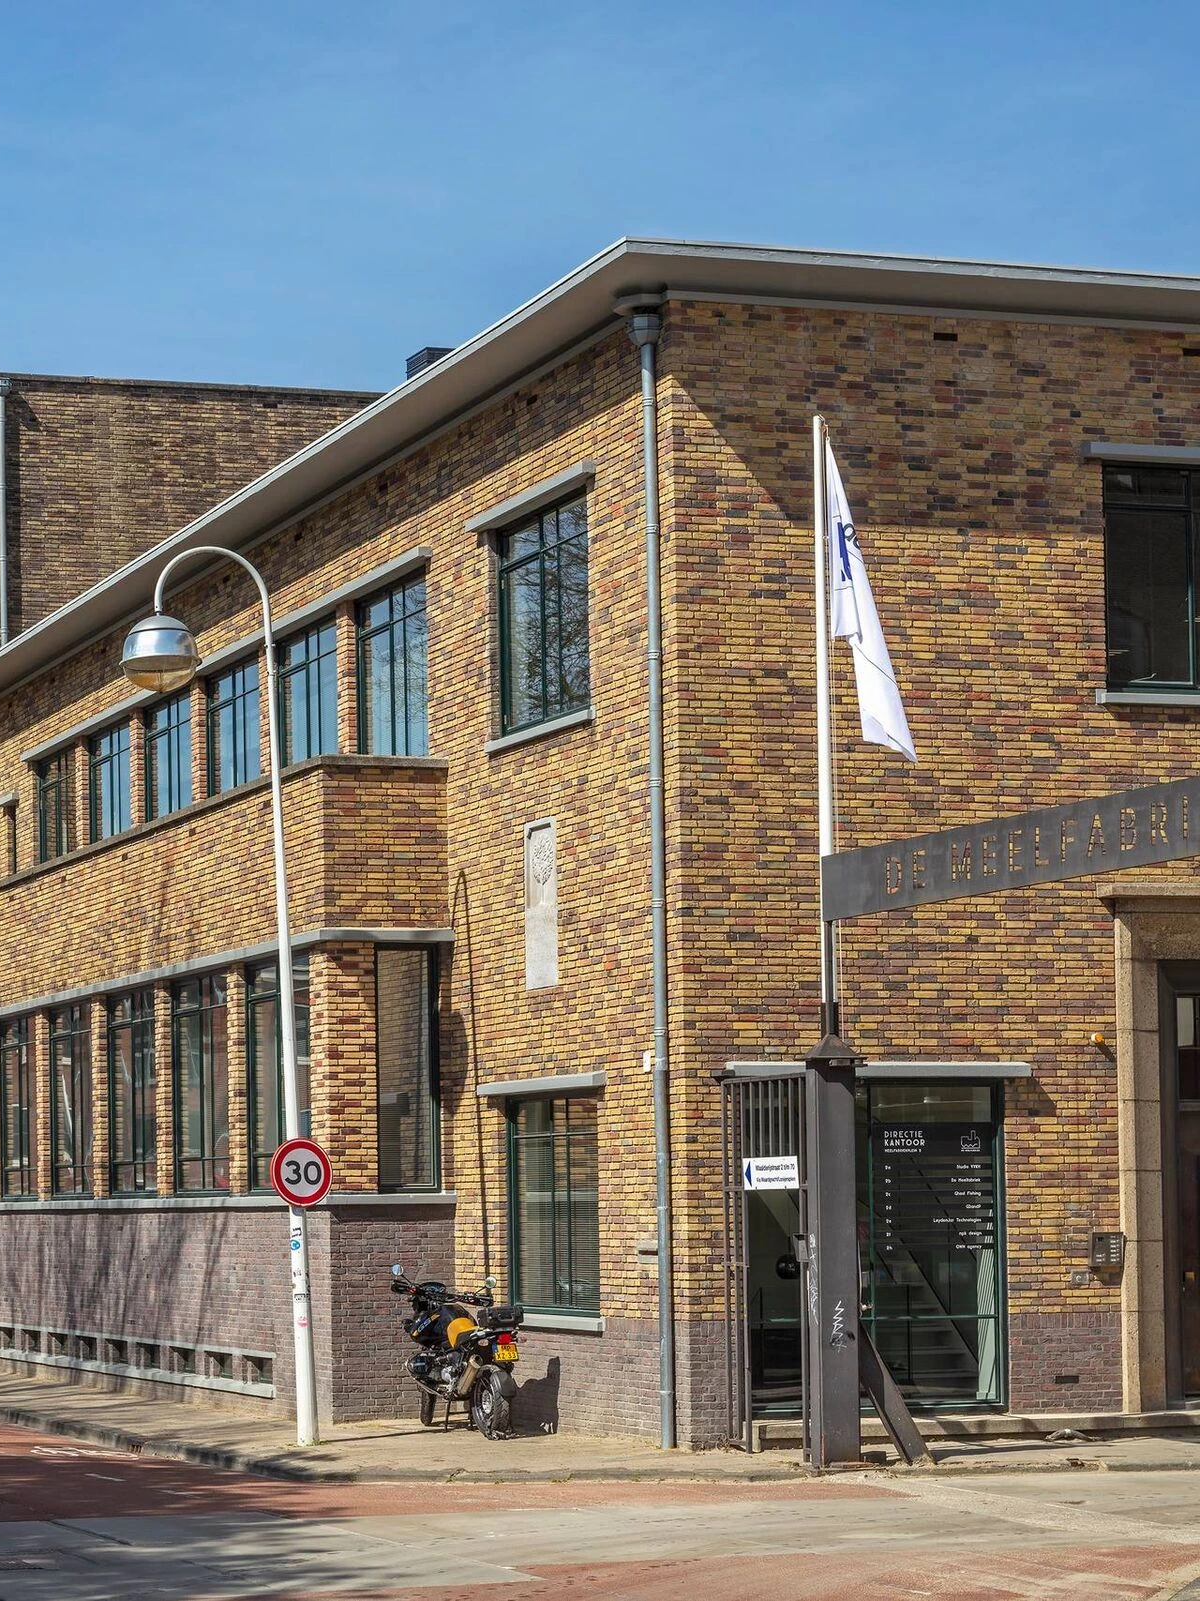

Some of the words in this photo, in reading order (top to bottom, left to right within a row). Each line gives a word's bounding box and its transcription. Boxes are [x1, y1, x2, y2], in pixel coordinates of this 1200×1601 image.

[885, 849, 927, 895] DE
[884, 1130, 923, 1139] DIRECTIE
[884, 1139, 926, 1147] KANTOOR
[284, 1160, 322, 1186] 30
